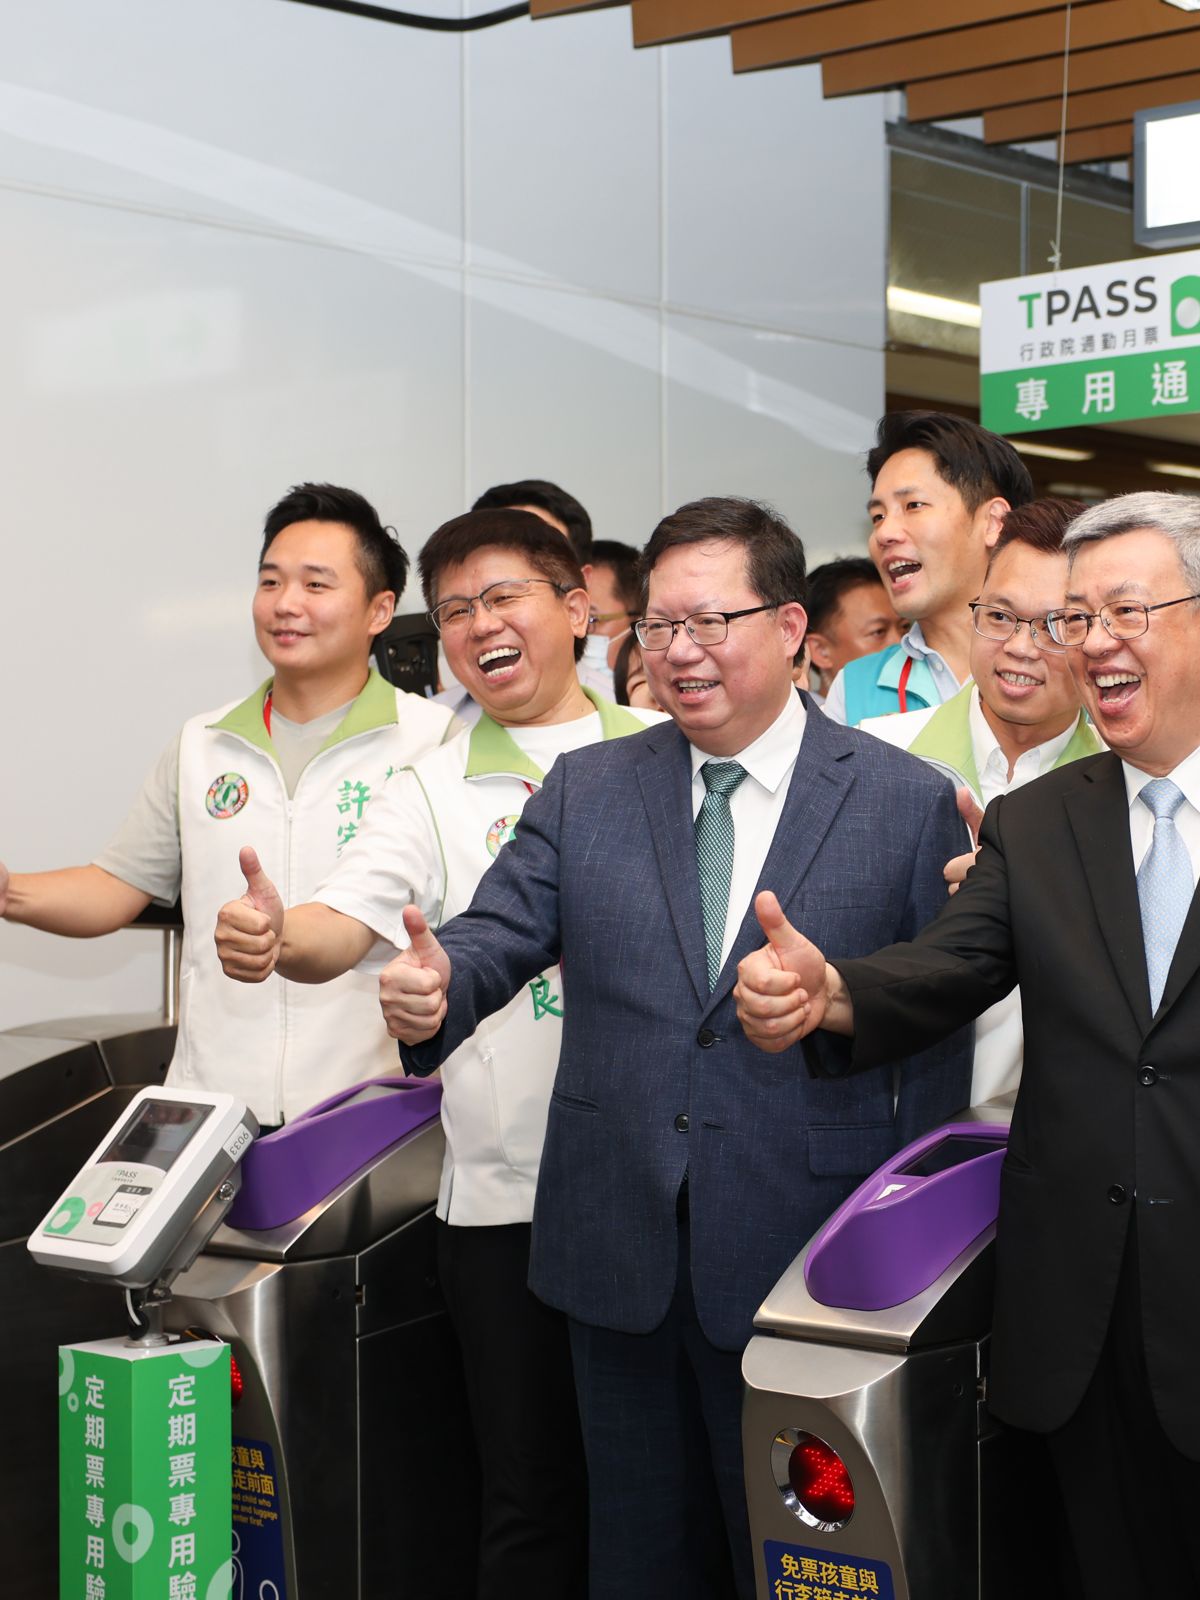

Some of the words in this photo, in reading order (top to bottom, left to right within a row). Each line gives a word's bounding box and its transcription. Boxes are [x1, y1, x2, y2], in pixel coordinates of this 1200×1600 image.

[1018, 275, 1158, 329] TPASS
[1020, 326, 1158, 363] 行政院通勤月票
[229, 1130, 250, 1156] 9033
[167, 1373, 197, 1600] 定期票專用驗
[232, 1469, 275, 1497] 走前面
[780, 1553, 879, 1595] 免票孩童與
